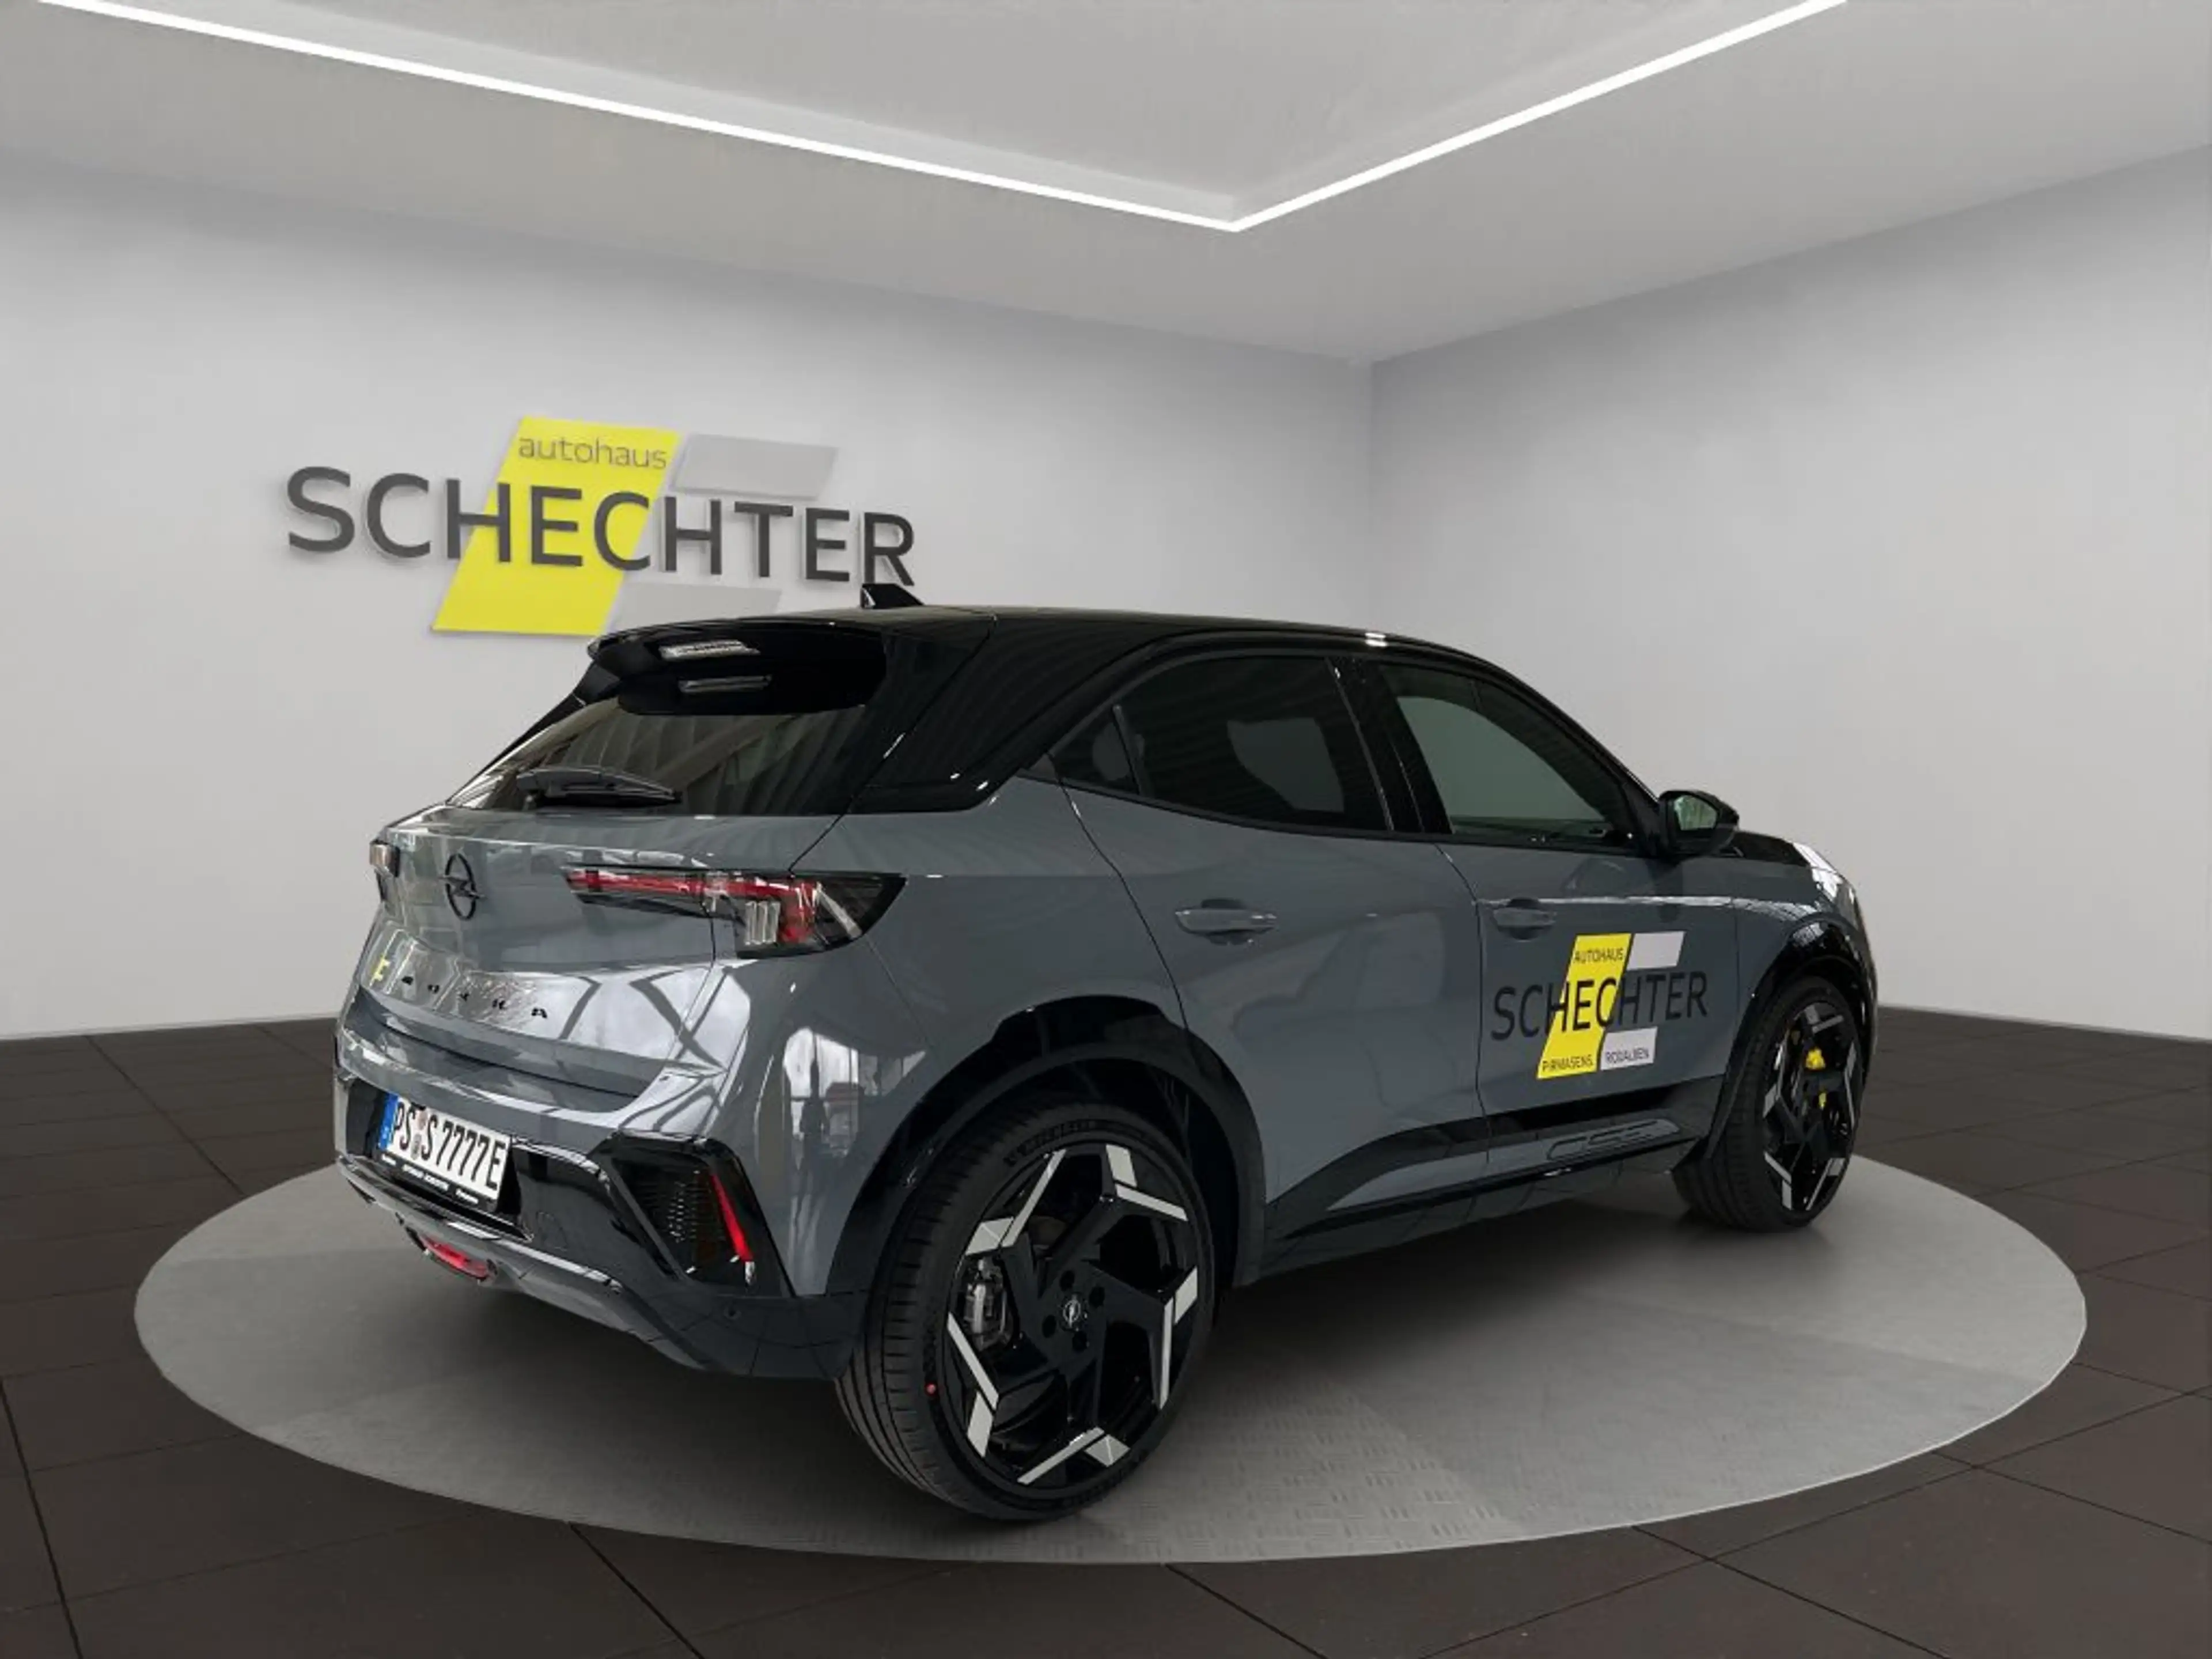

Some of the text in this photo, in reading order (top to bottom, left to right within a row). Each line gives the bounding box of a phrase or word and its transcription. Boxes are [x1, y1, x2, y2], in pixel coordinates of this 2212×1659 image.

[518, 435, 667, 469] autohaus
[286, 465, 915, 586] SCHECHTER
[1573, 946, 1623, 964] AUTOHAUS
[1491, 971, 1707, 1041] SCHECHTER
